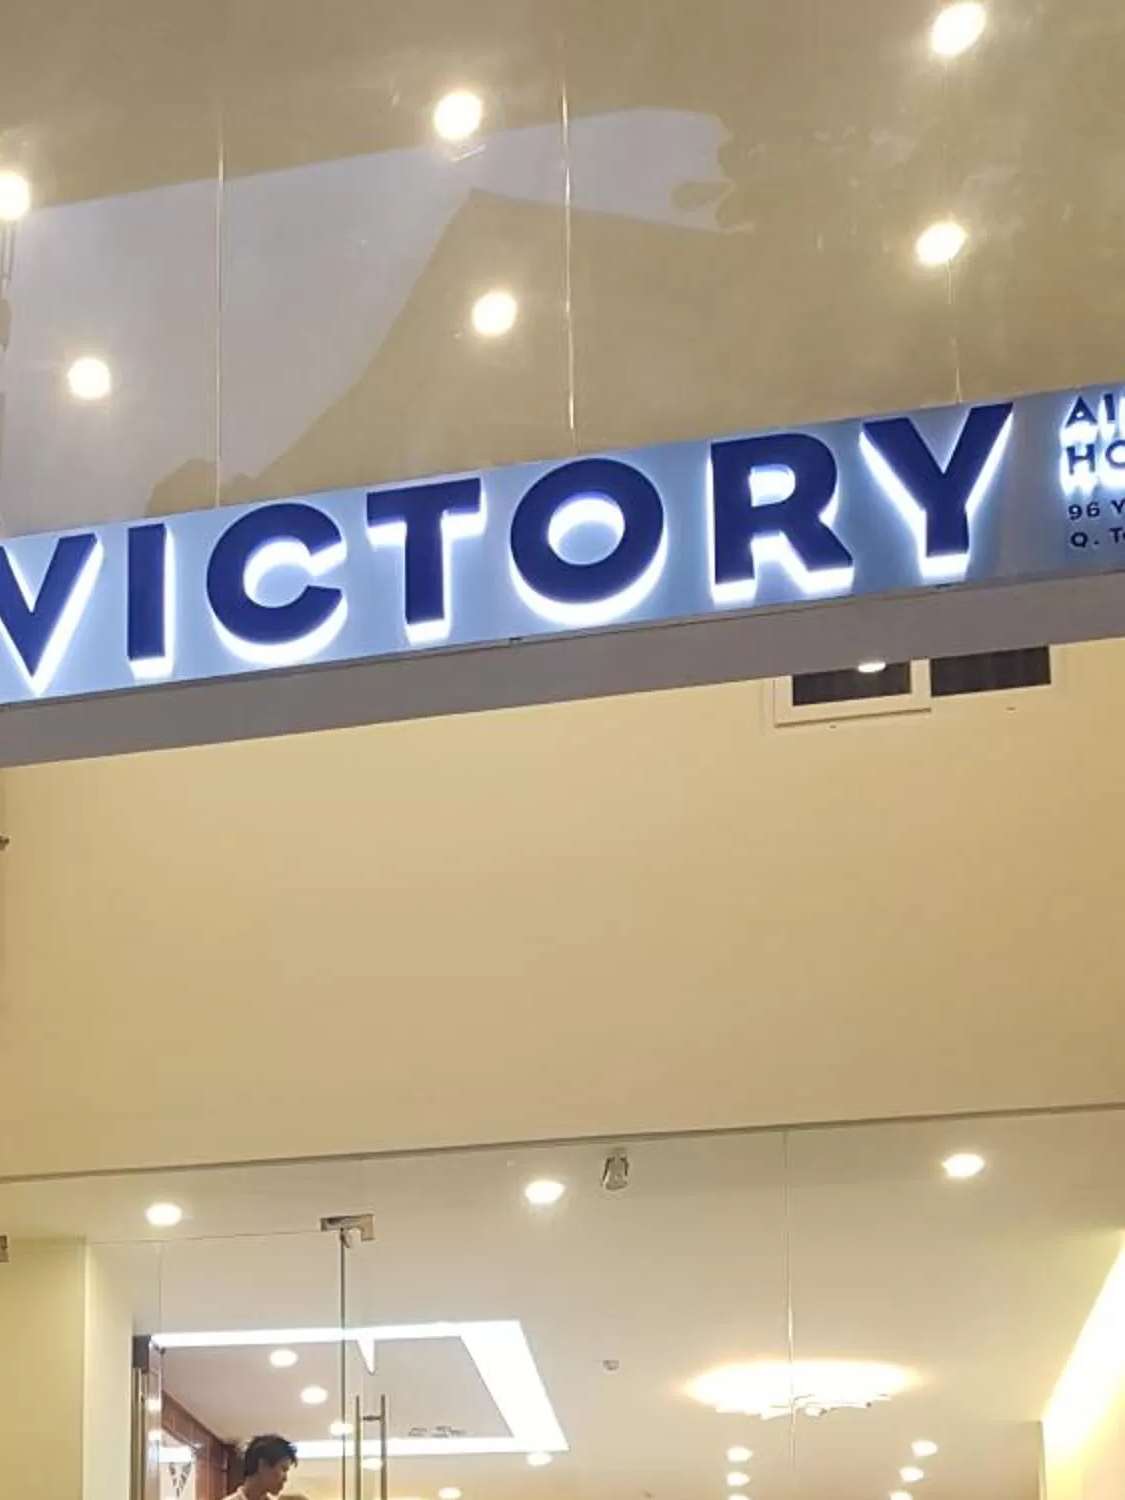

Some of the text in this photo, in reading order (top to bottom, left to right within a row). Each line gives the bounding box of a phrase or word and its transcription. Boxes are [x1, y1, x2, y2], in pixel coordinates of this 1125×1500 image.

[1068, 502, 1101, 520] 96
[1070, 527, 1125, 549] Q. T
